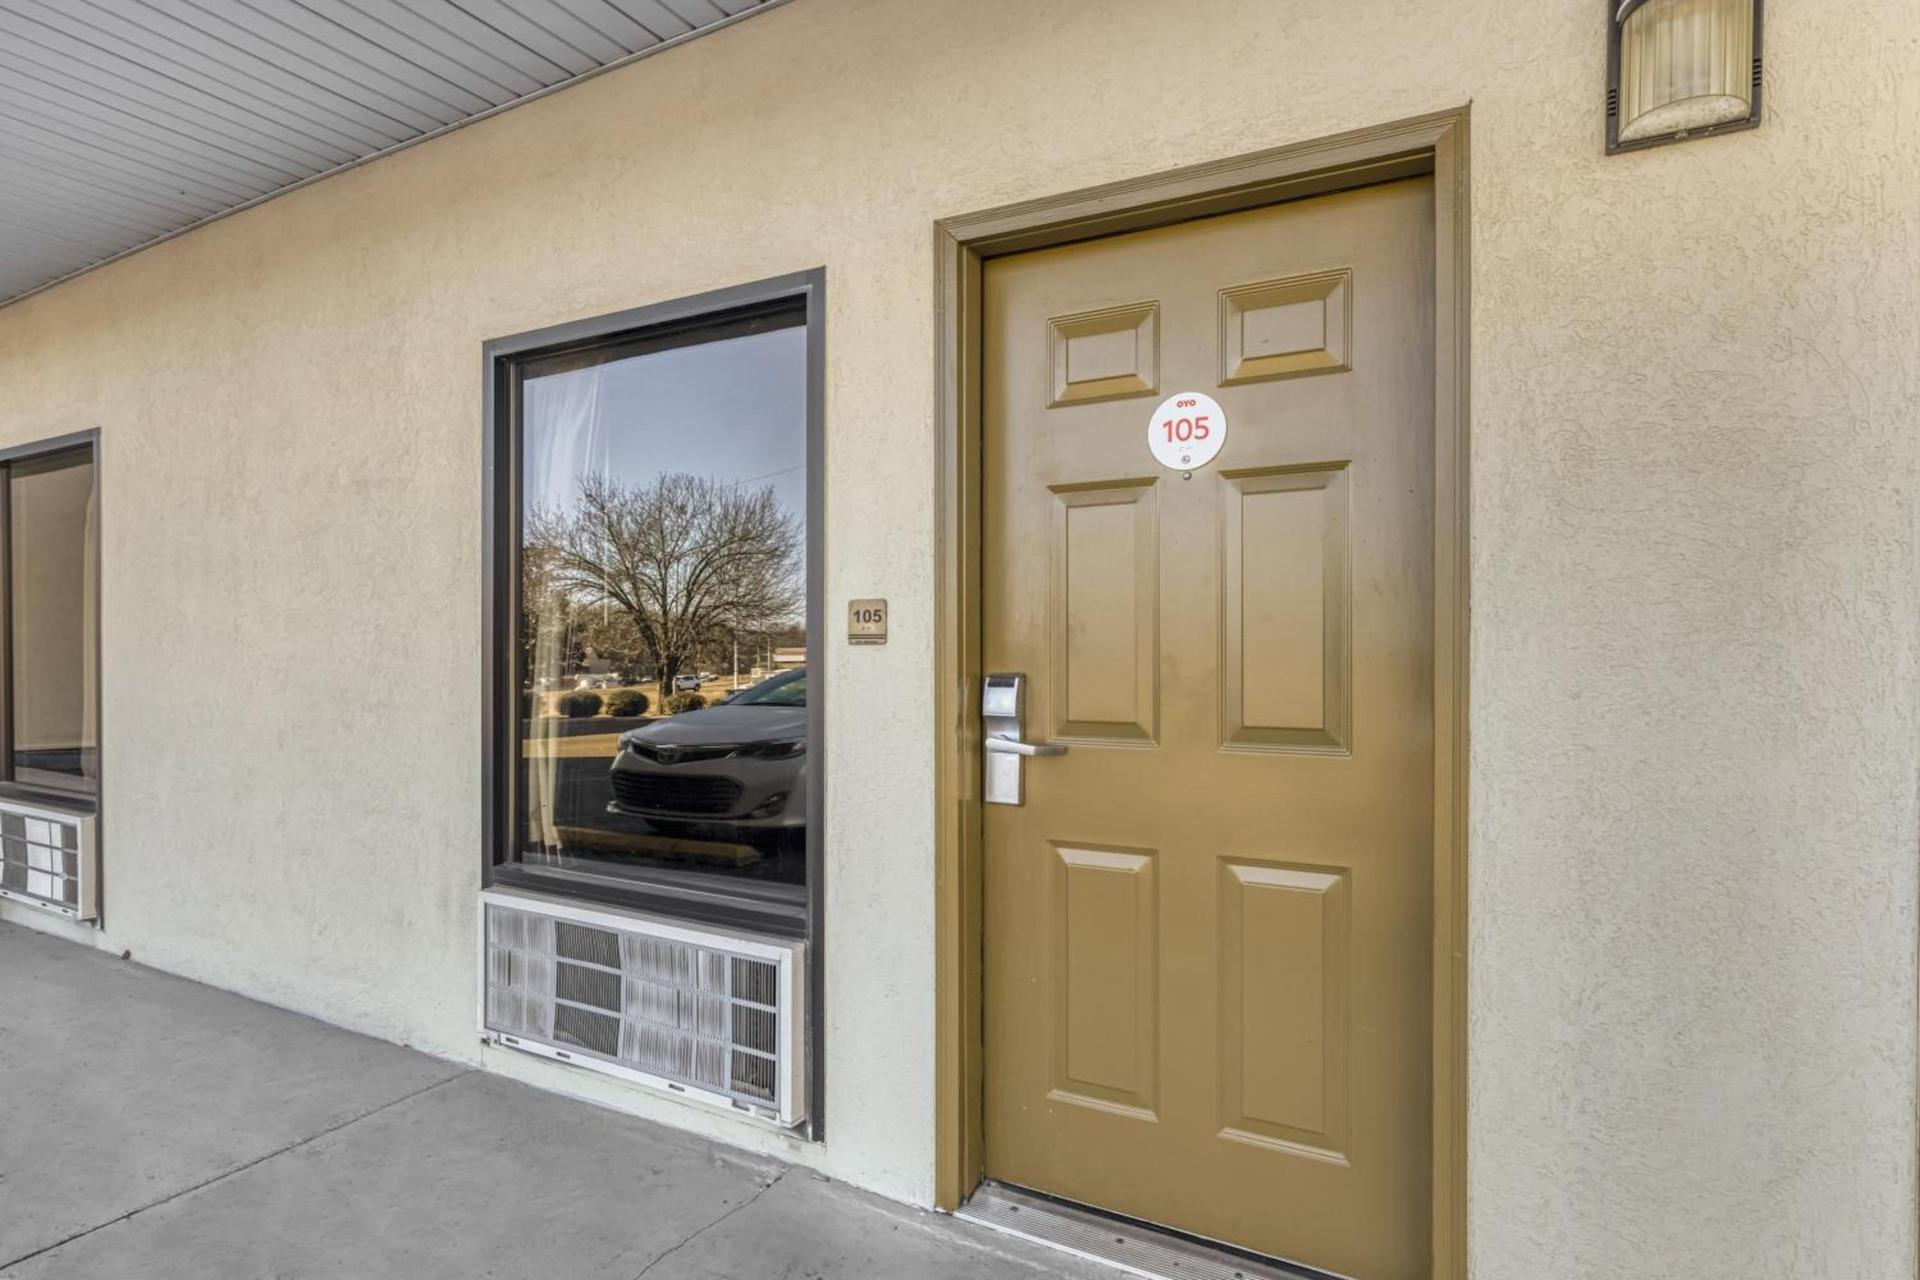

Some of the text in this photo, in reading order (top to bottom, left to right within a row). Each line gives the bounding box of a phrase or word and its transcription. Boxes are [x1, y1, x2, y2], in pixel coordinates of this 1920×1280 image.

[1176, 399, 1196, 408] OYO
[1162, 416, 1210, 443] 105
[853, 608, 882, 624] 105
